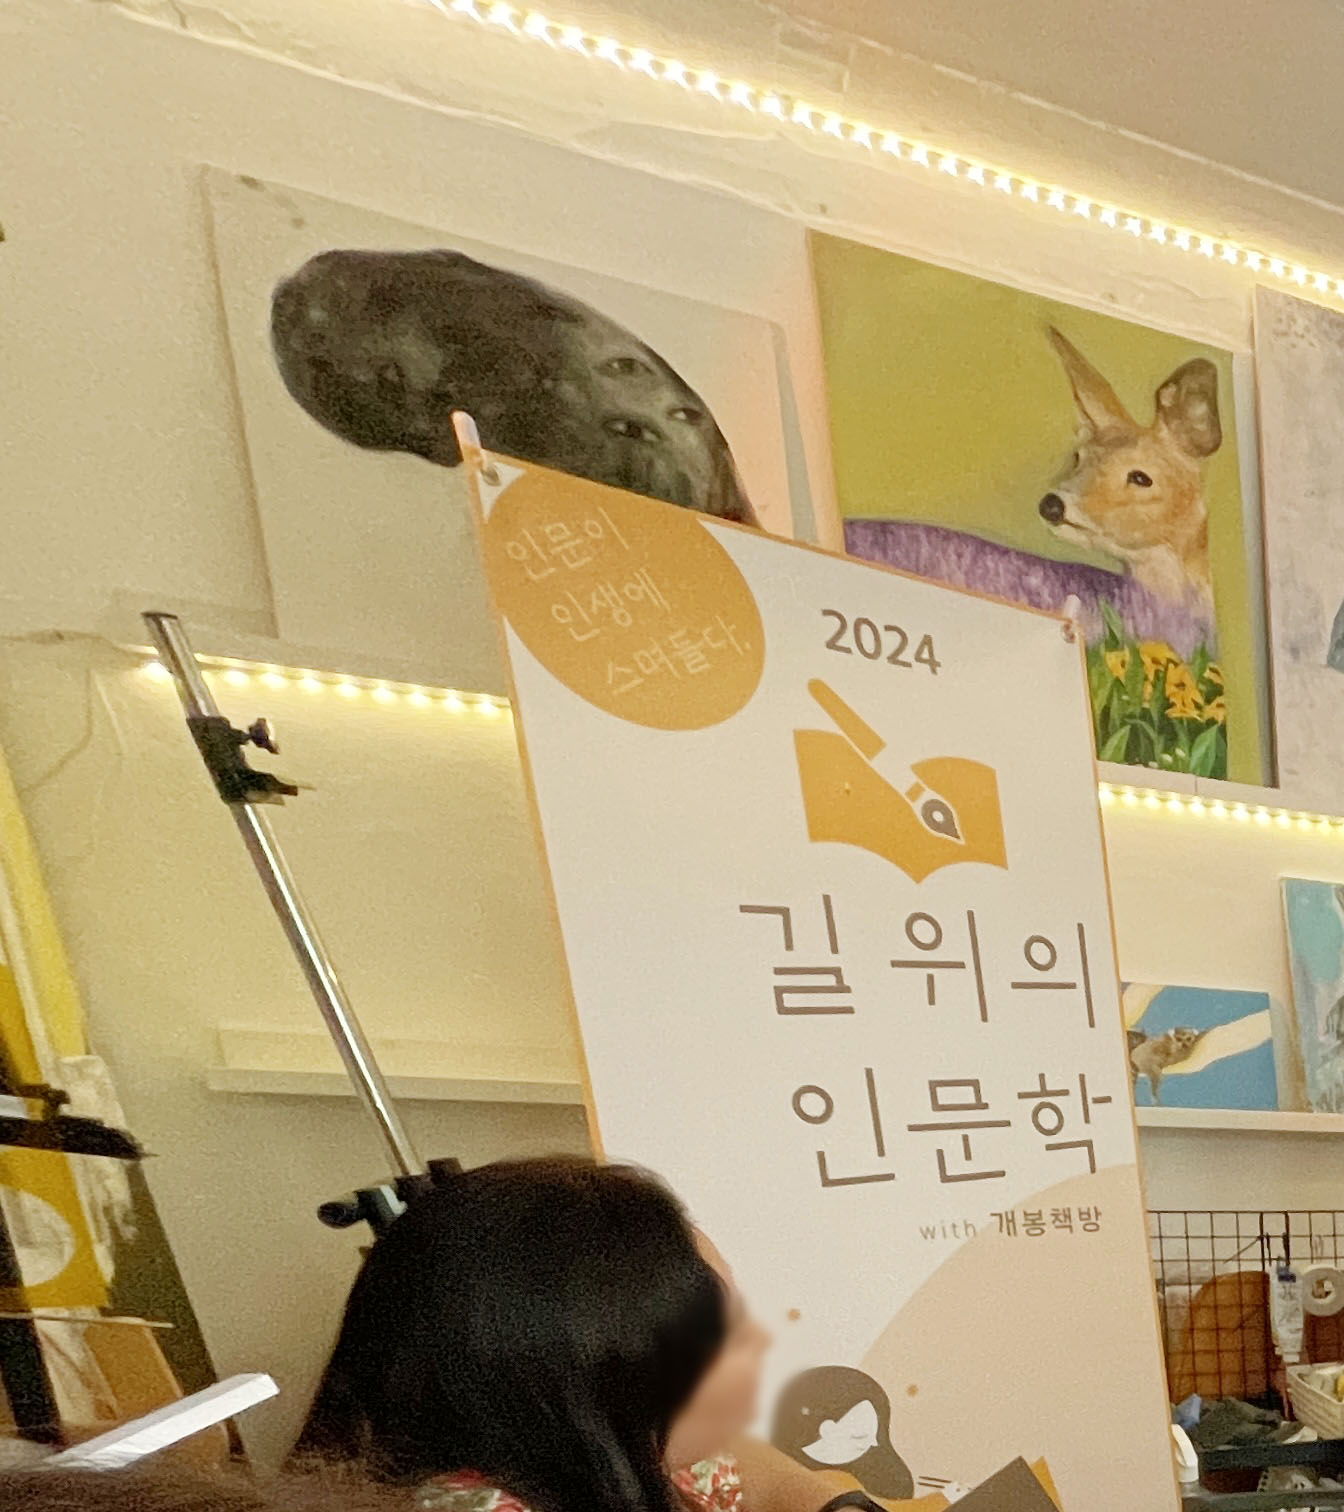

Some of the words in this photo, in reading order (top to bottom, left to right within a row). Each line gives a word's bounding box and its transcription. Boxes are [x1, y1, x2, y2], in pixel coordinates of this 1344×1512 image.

[507, 507, 630, 580] 인문이
[551, 567, 672, 642] 인생에
[821, 609, 941, 675] 2024
[608, 615, 750, 695] 스며들다.
[739, 894, 855, 1015] 길
[890, 910, 1095, 1028] 위의
[792, 1067, 1112, 1187] 인문학
[920, 1219, 977, 1240] with
[990, 1205, 1102, 1237] 개봉책방
